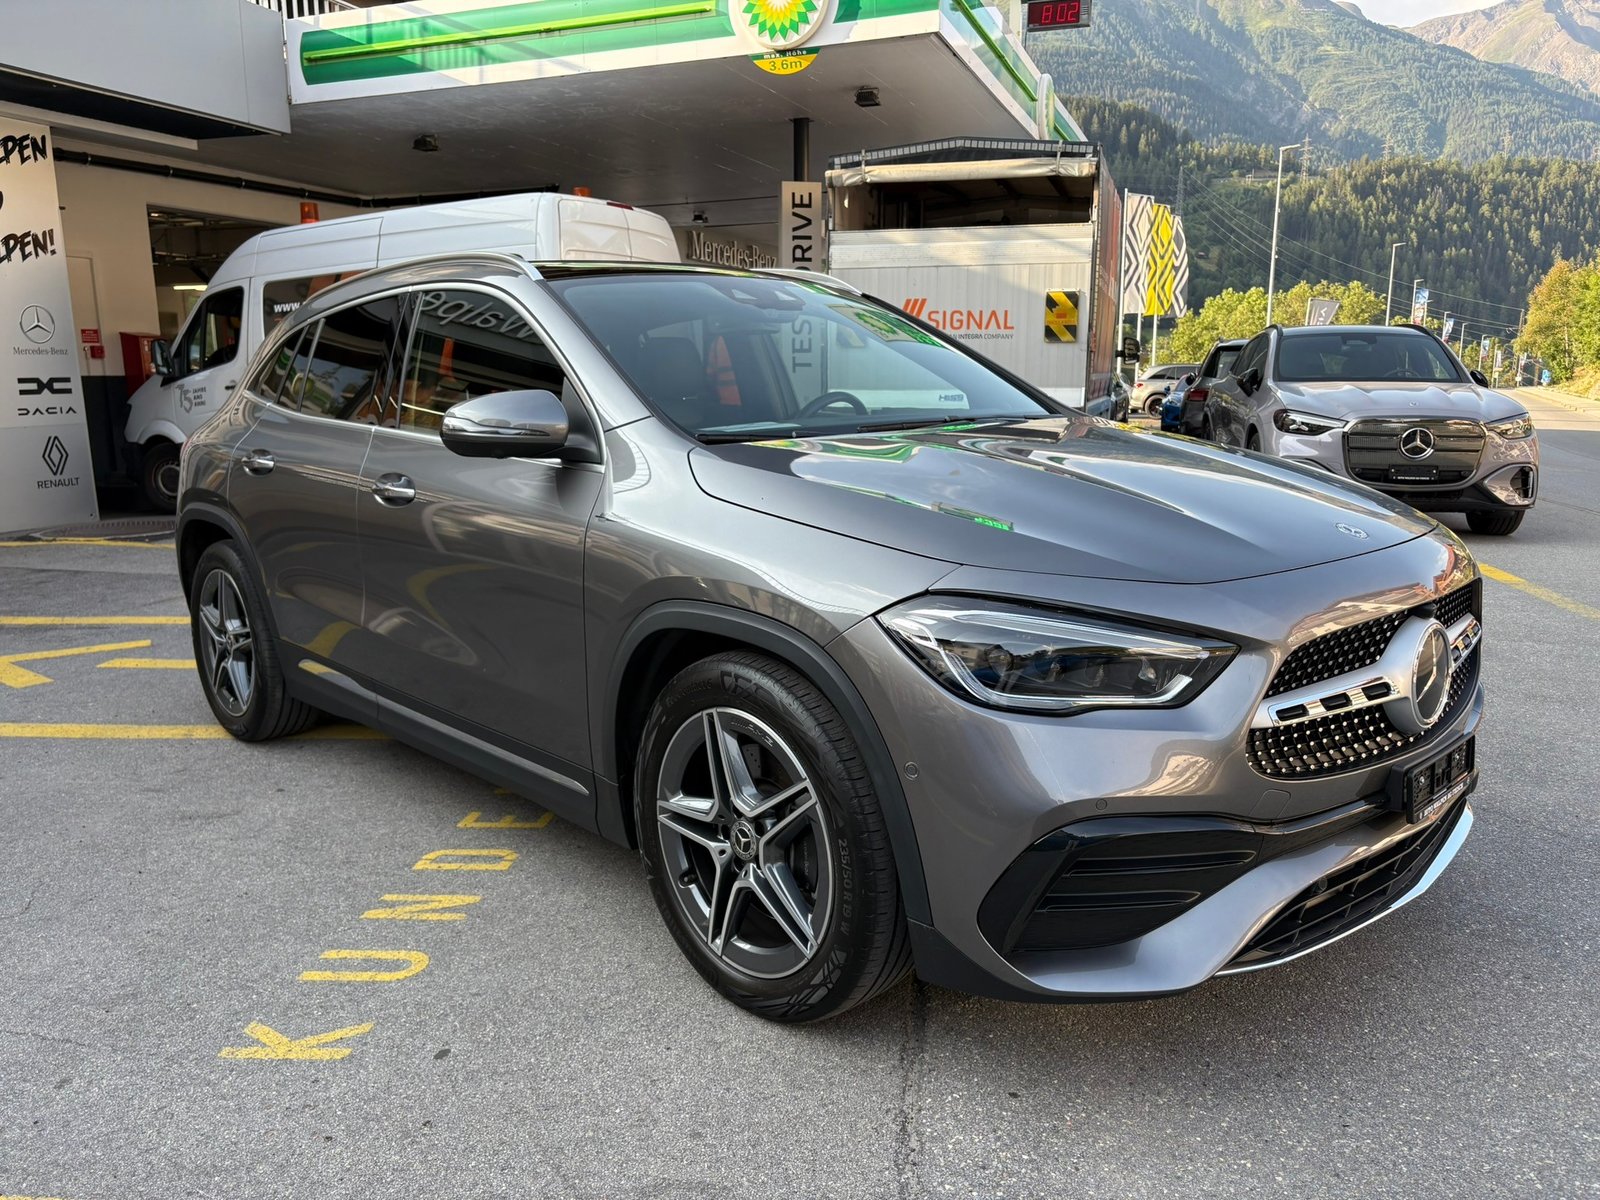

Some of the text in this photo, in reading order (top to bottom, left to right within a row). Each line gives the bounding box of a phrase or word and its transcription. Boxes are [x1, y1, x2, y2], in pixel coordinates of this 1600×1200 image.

[768, 59, 803, 72] 3.6m
[0, 134, 48, 165] PEN
[0, 228, 57, 263] PEN!
[692, 231, 778, 270] Mercedes-Benz
[791, 191, 813, 374] TES RIVE
[273, 301, 301, 314] www
[927, 309, 1015, 331] SIGNAL
[958, 333, 983, 341] INTEGRA
[984, 333, 1014, 341] COMPANY
[13, 346, 69, 356] Mercedes-Benz
[17, 406, 78, 416] DACIA
[37, 477, 80, 490] RENAULT
[217, 788, 556, 1061] KUNDE
